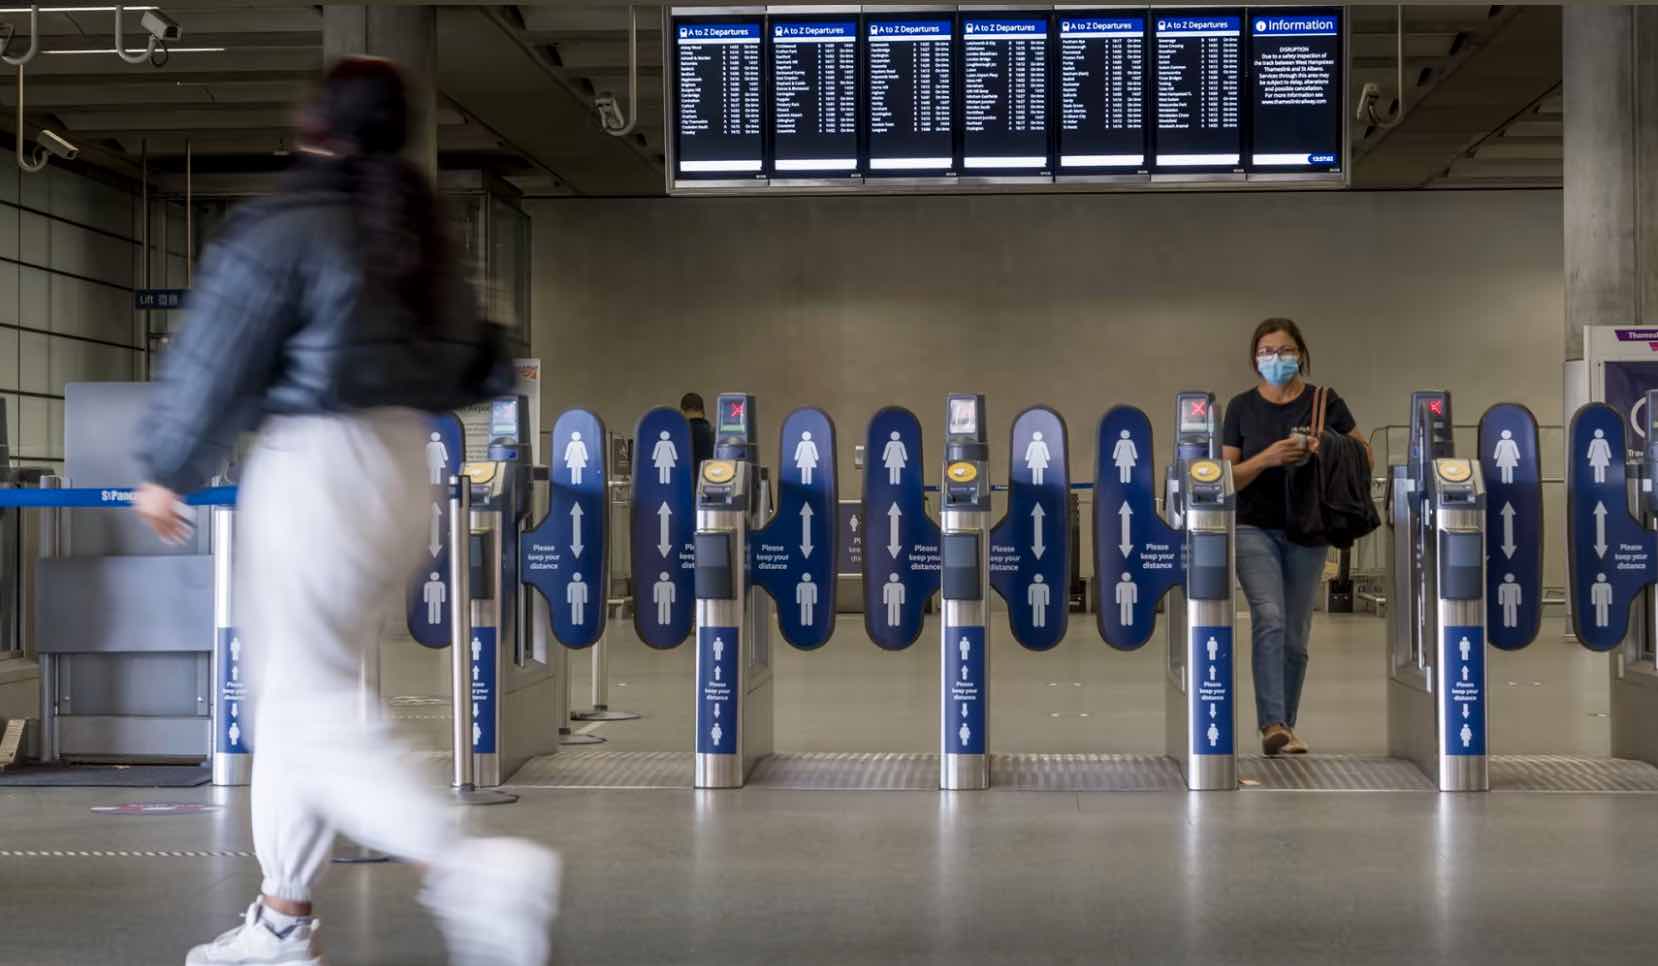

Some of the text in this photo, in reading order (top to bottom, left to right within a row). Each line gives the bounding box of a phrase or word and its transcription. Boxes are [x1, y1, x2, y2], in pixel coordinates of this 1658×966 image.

[901, 25, 939, 34] Departures
[996, 24, 1035, 32] Departures
[1093, 22, 1132, 30] Departures
[1189, 21, 1228, 30] Departures
[1269, 20, 1333, 30] Information
[710, 28, 749, 37] Departures
[806, 27, 844, 36] Departures
[528, 552, 560, 562] keep your
[756, 553, 773, 562] keep
[909, 553, 927, 562] keep
[1005, 556, 1021, 564] your
[1140, 552, 1158, 560] keep
[1632, 554, 1648, 562] your
